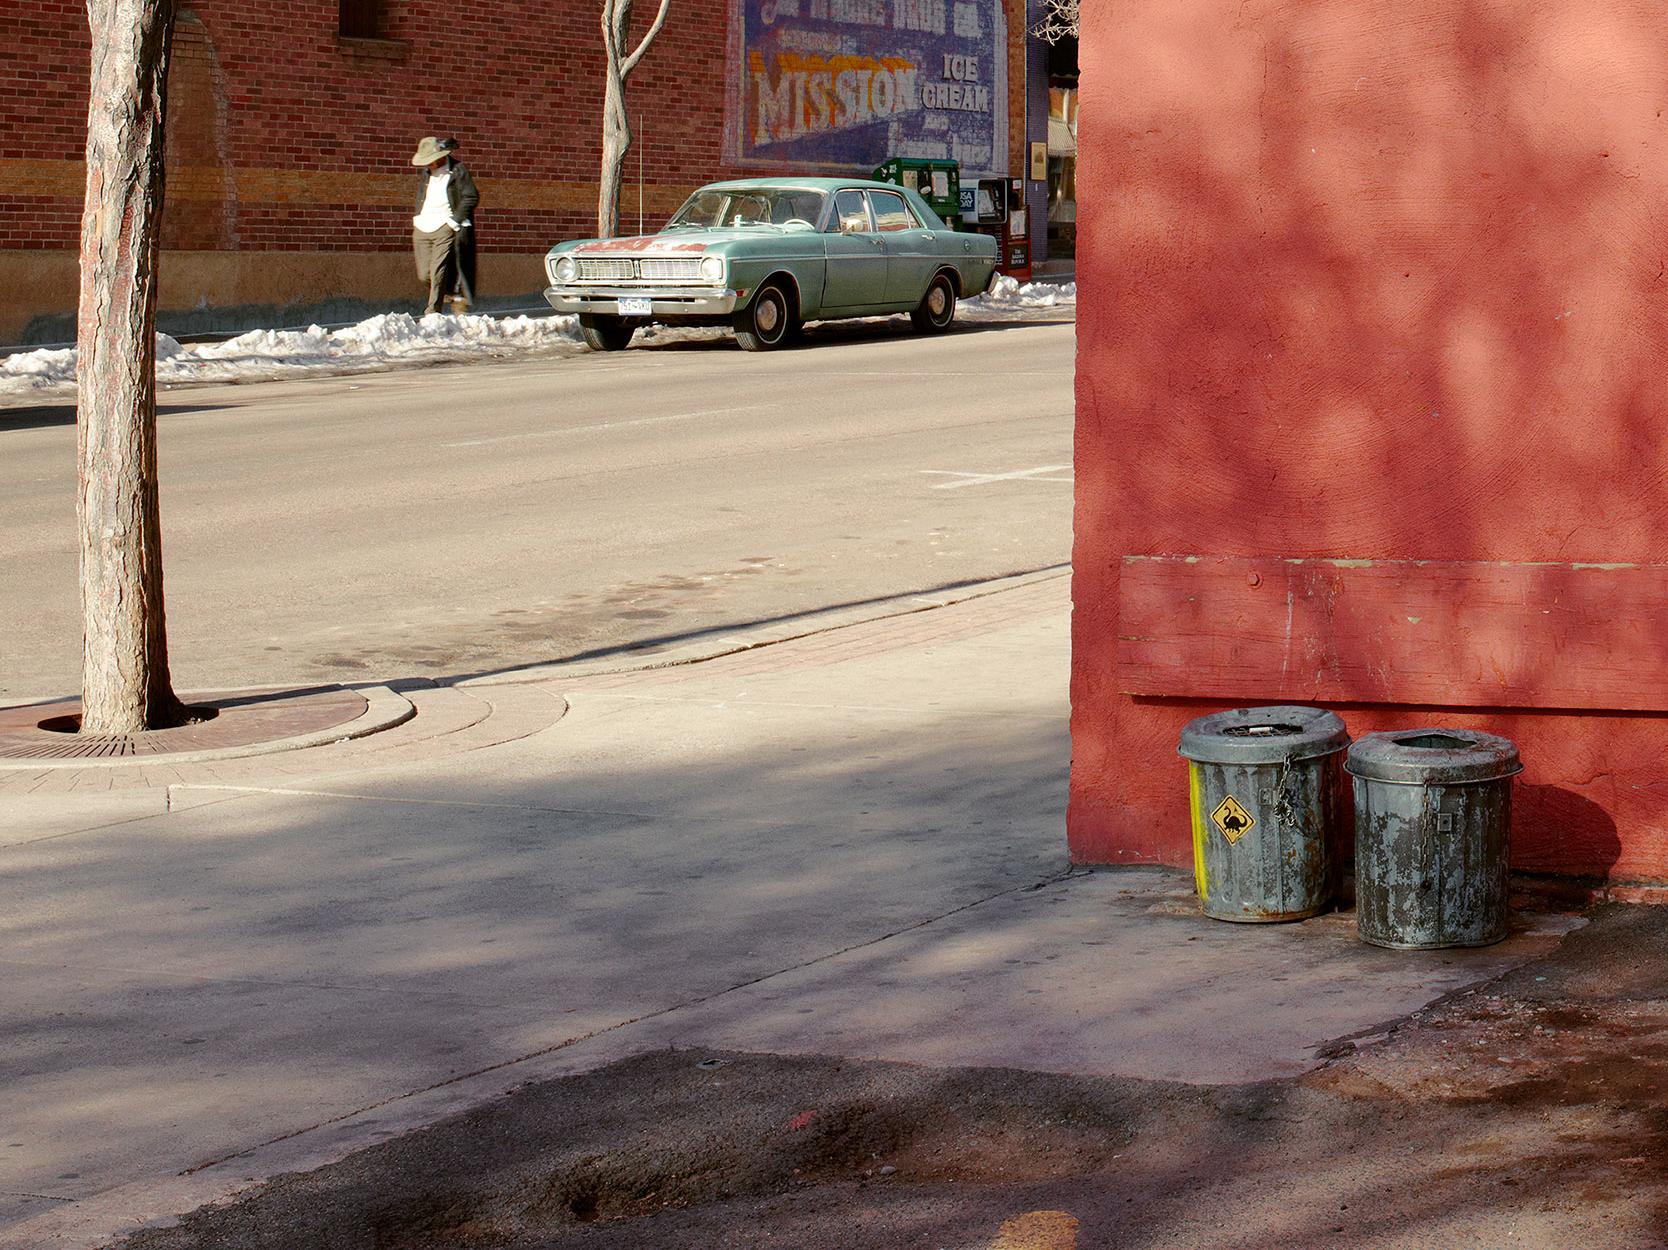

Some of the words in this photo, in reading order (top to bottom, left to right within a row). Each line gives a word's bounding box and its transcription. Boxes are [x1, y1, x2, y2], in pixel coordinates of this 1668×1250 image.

[941, 53, 979, 83] ICE
[749, 52, 919, 146] MISSION
[921, 82, 989, 114] CREAM
